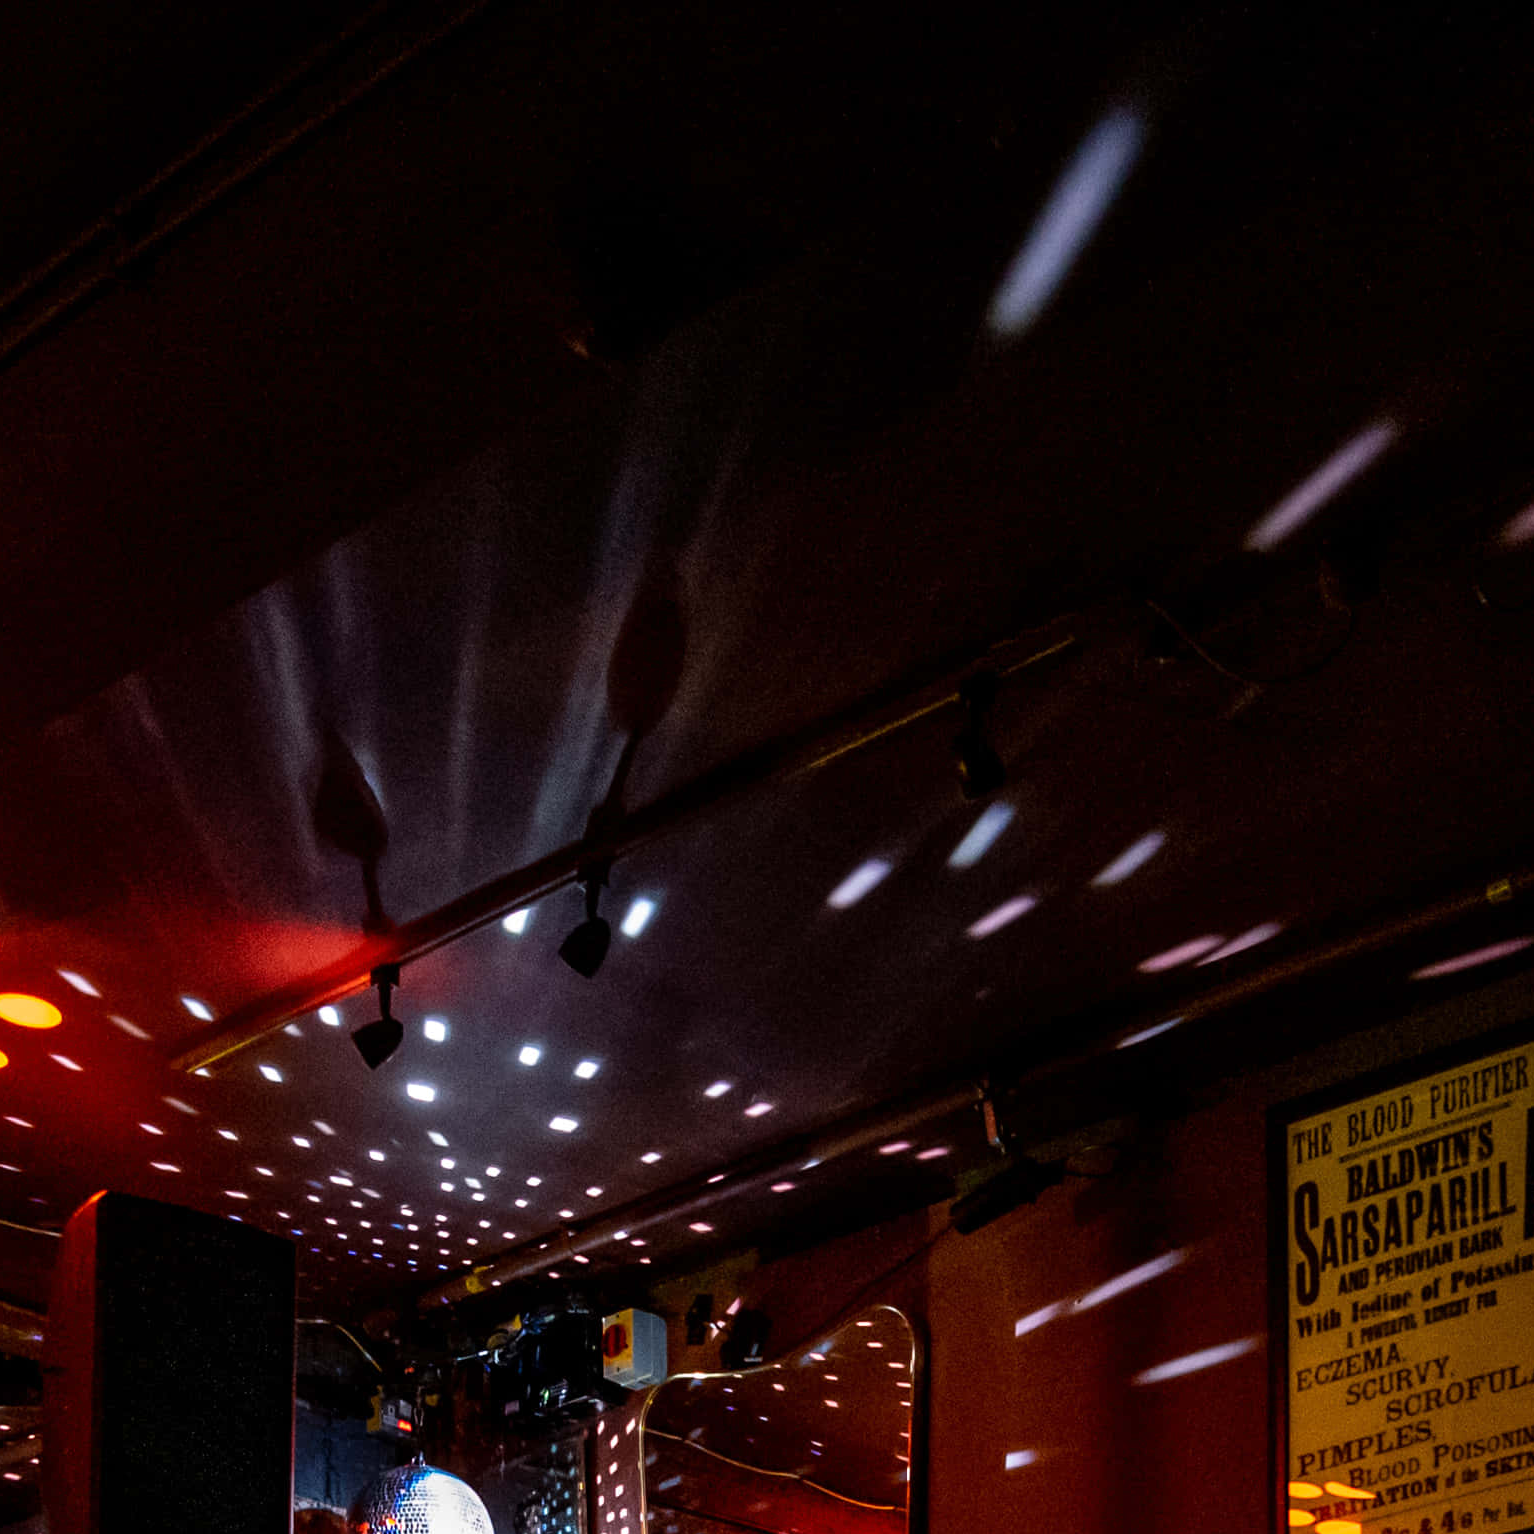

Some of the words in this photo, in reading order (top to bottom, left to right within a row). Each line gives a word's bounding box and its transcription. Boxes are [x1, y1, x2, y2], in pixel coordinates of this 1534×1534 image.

[1293, 1121, 1332, 1164] THE
[1347, 1095, 1414, 1148] BLOOD
[1430, 1055, 1529, 1119] PURIFIER
[1347, 1120, 1493, 1203] BALDWIN'S
[1338, 1268, 1368, 1295] AND
[1375, 1242, 1453, 1285] PERUVIAN
[1459, 1226, 1504, 1259] BARK
[1297, 1309, 1341, 1338] With
[1422, 1279, 1441, 1302] of
[1349, 1457, 1420, 1488] BLOOD
